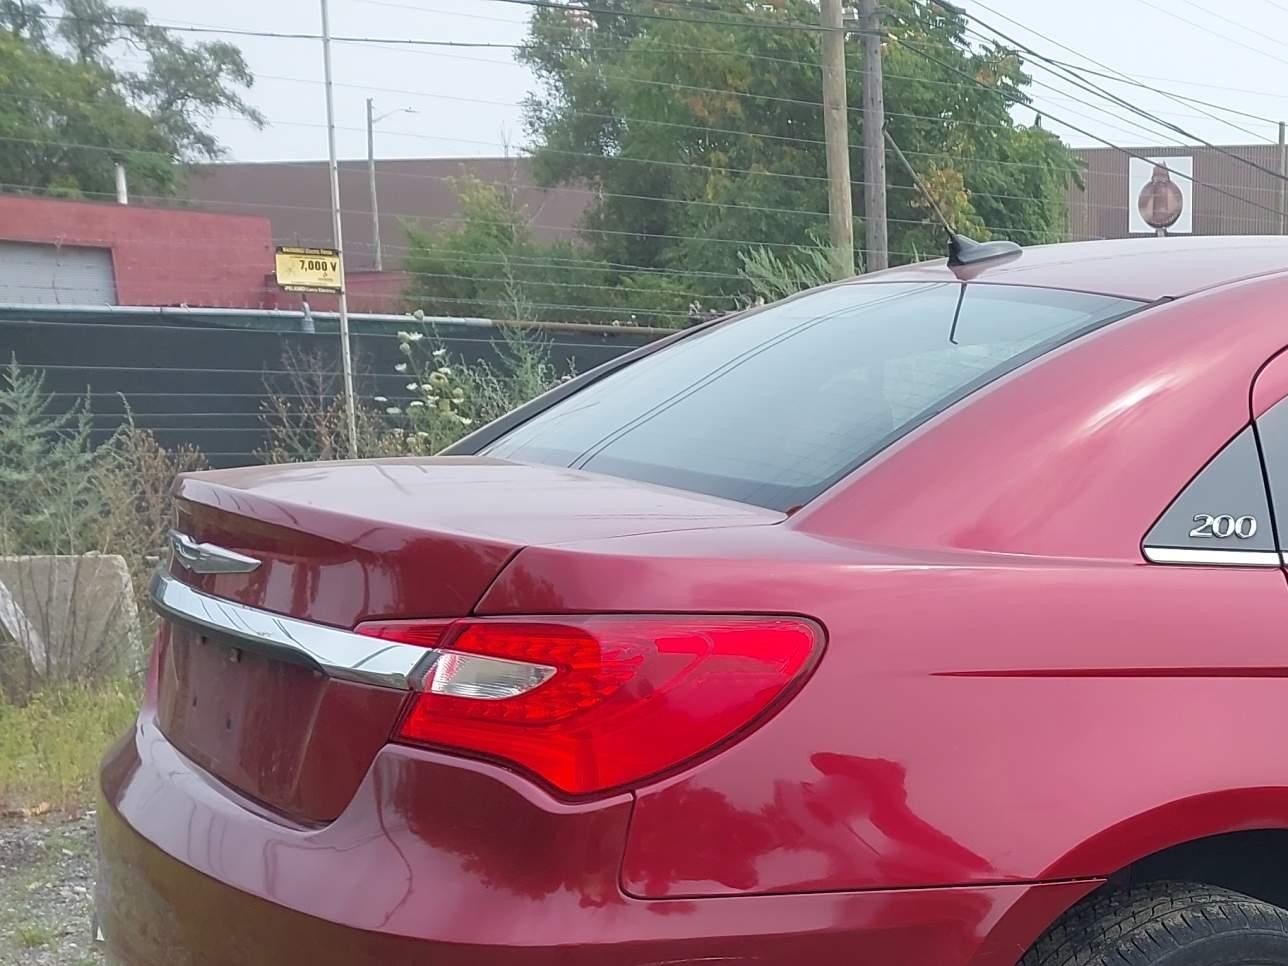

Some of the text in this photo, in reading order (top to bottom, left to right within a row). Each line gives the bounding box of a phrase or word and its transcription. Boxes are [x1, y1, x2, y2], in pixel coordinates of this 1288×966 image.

[299, 259, 337, 272] 7,000 V
[1189, 514, 1257, 539] 200
